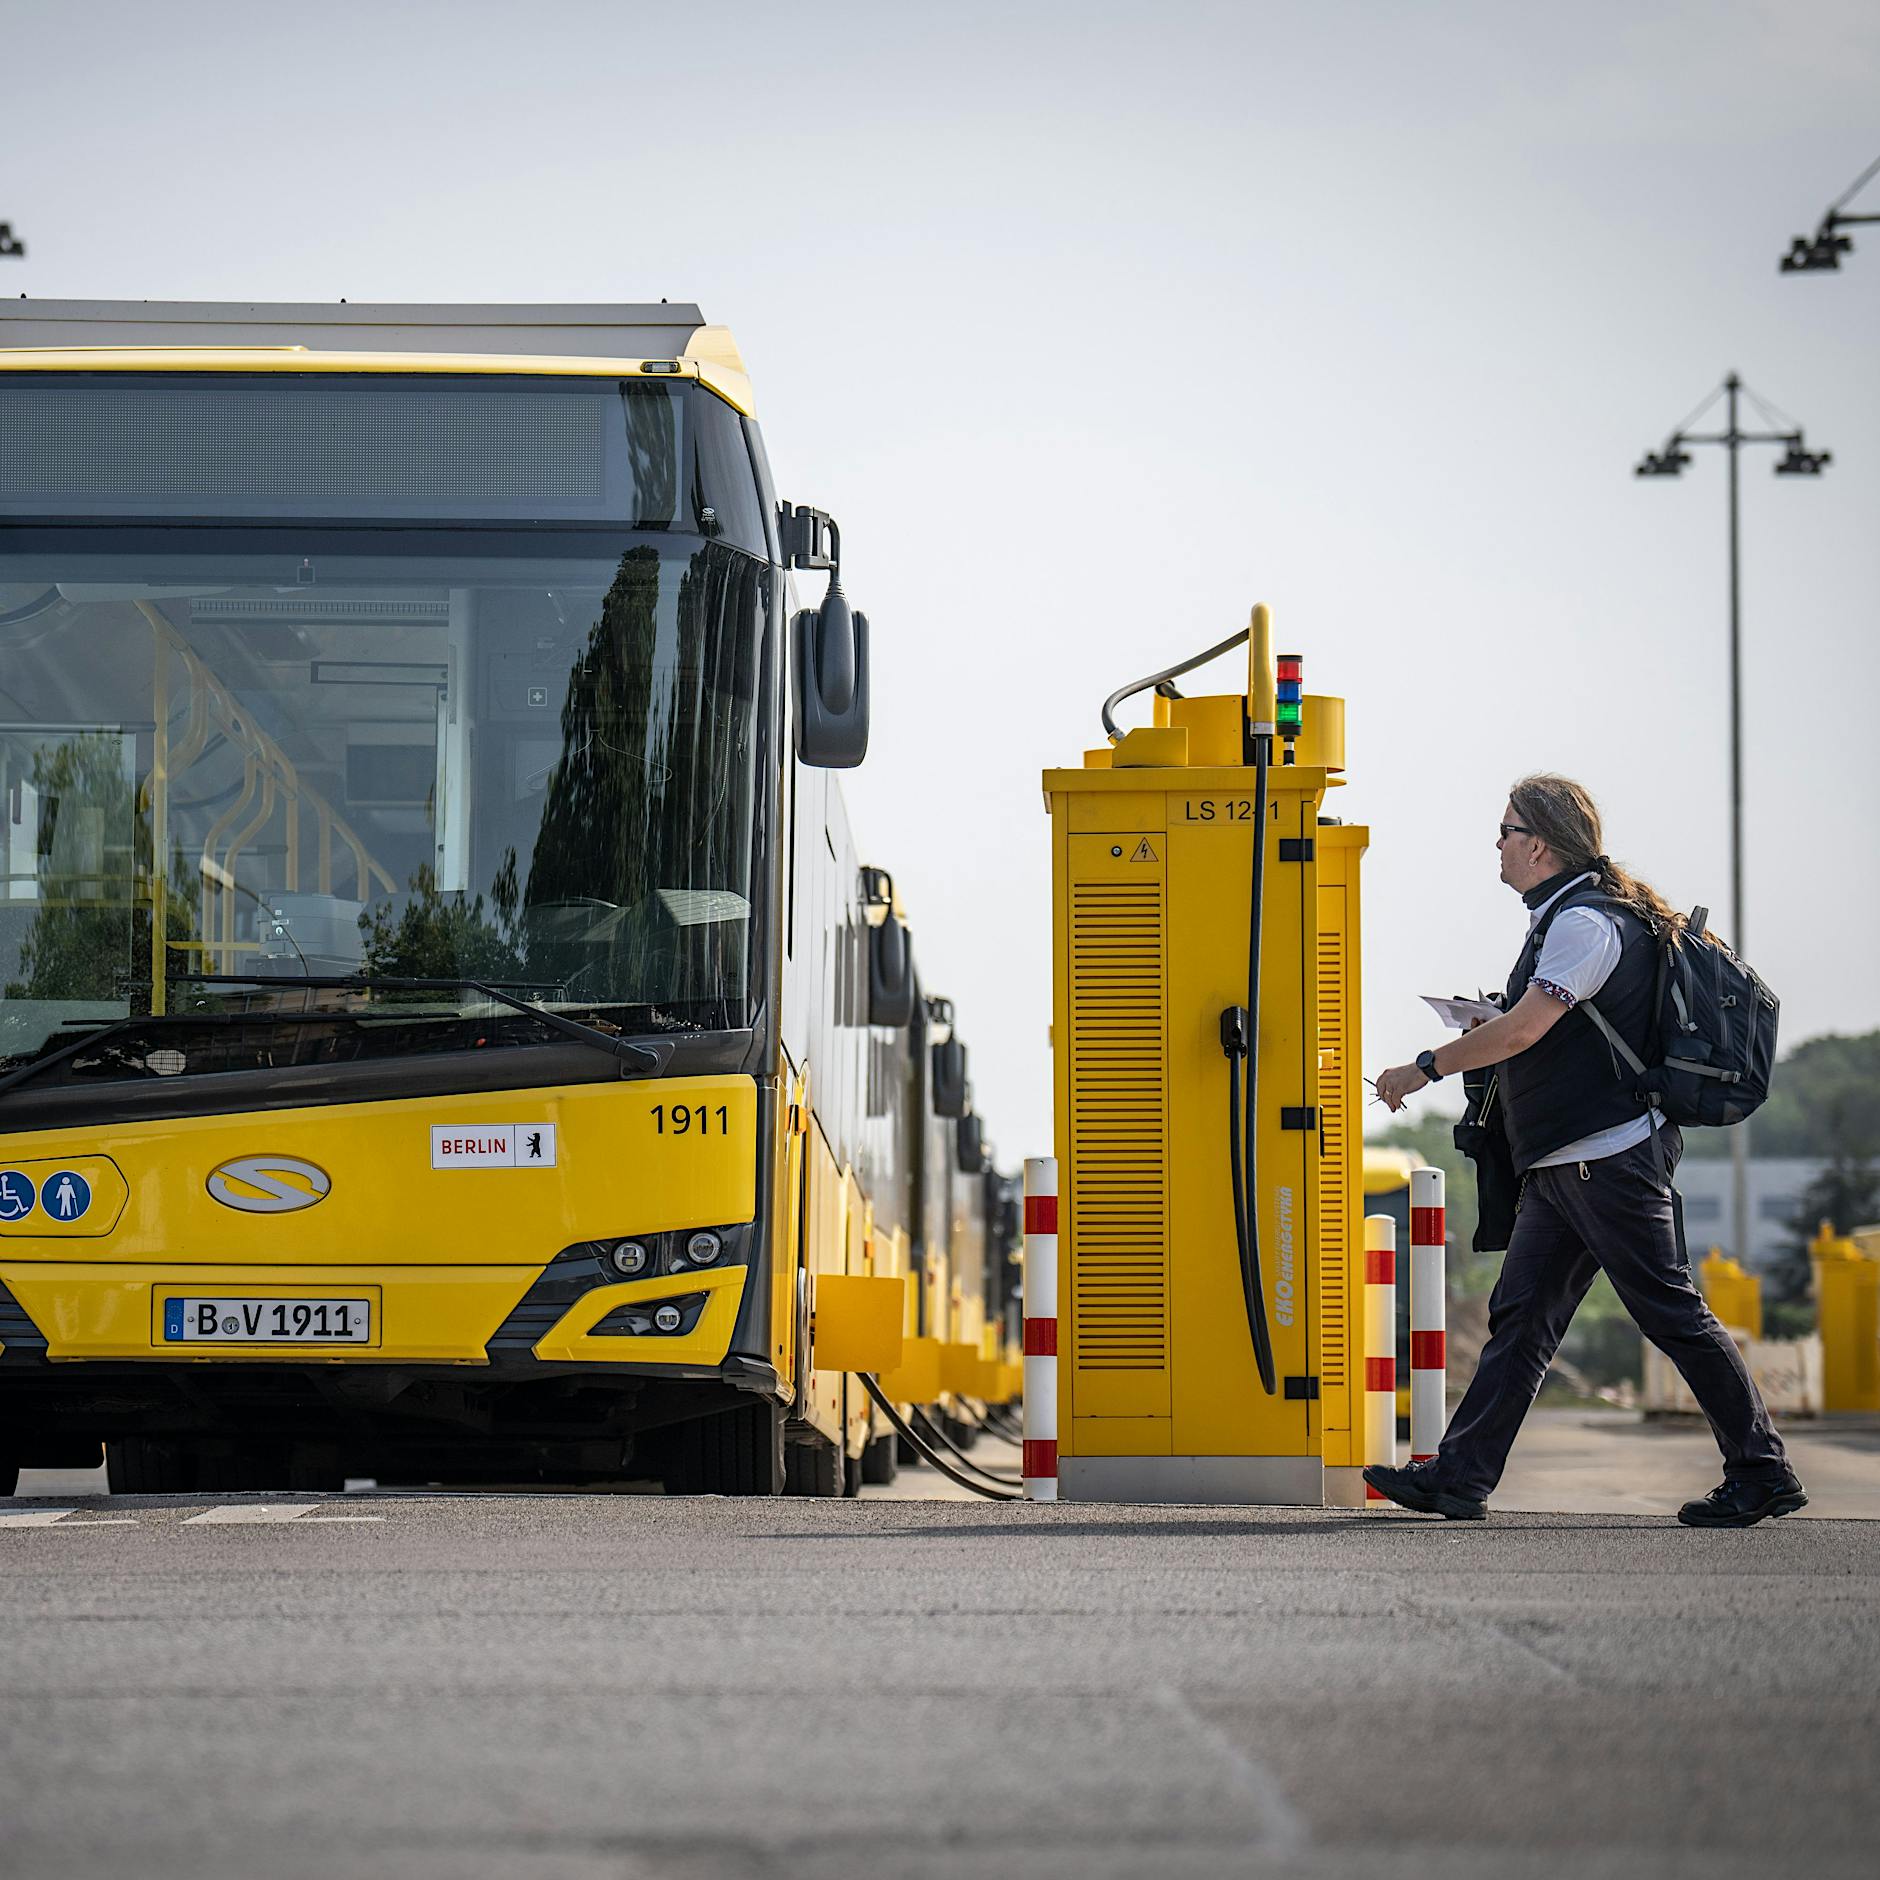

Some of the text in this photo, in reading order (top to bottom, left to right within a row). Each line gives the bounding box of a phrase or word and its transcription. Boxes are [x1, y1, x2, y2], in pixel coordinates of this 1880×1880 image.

[1186, 801, 1278, 820] LS 121
[650, 1104, 728, 1135] 1911
[441, 1138, 507, 1155] BERLIN
[170, 1324, 178, 1334] D
[271, 1304, 353, 1336] 1911
